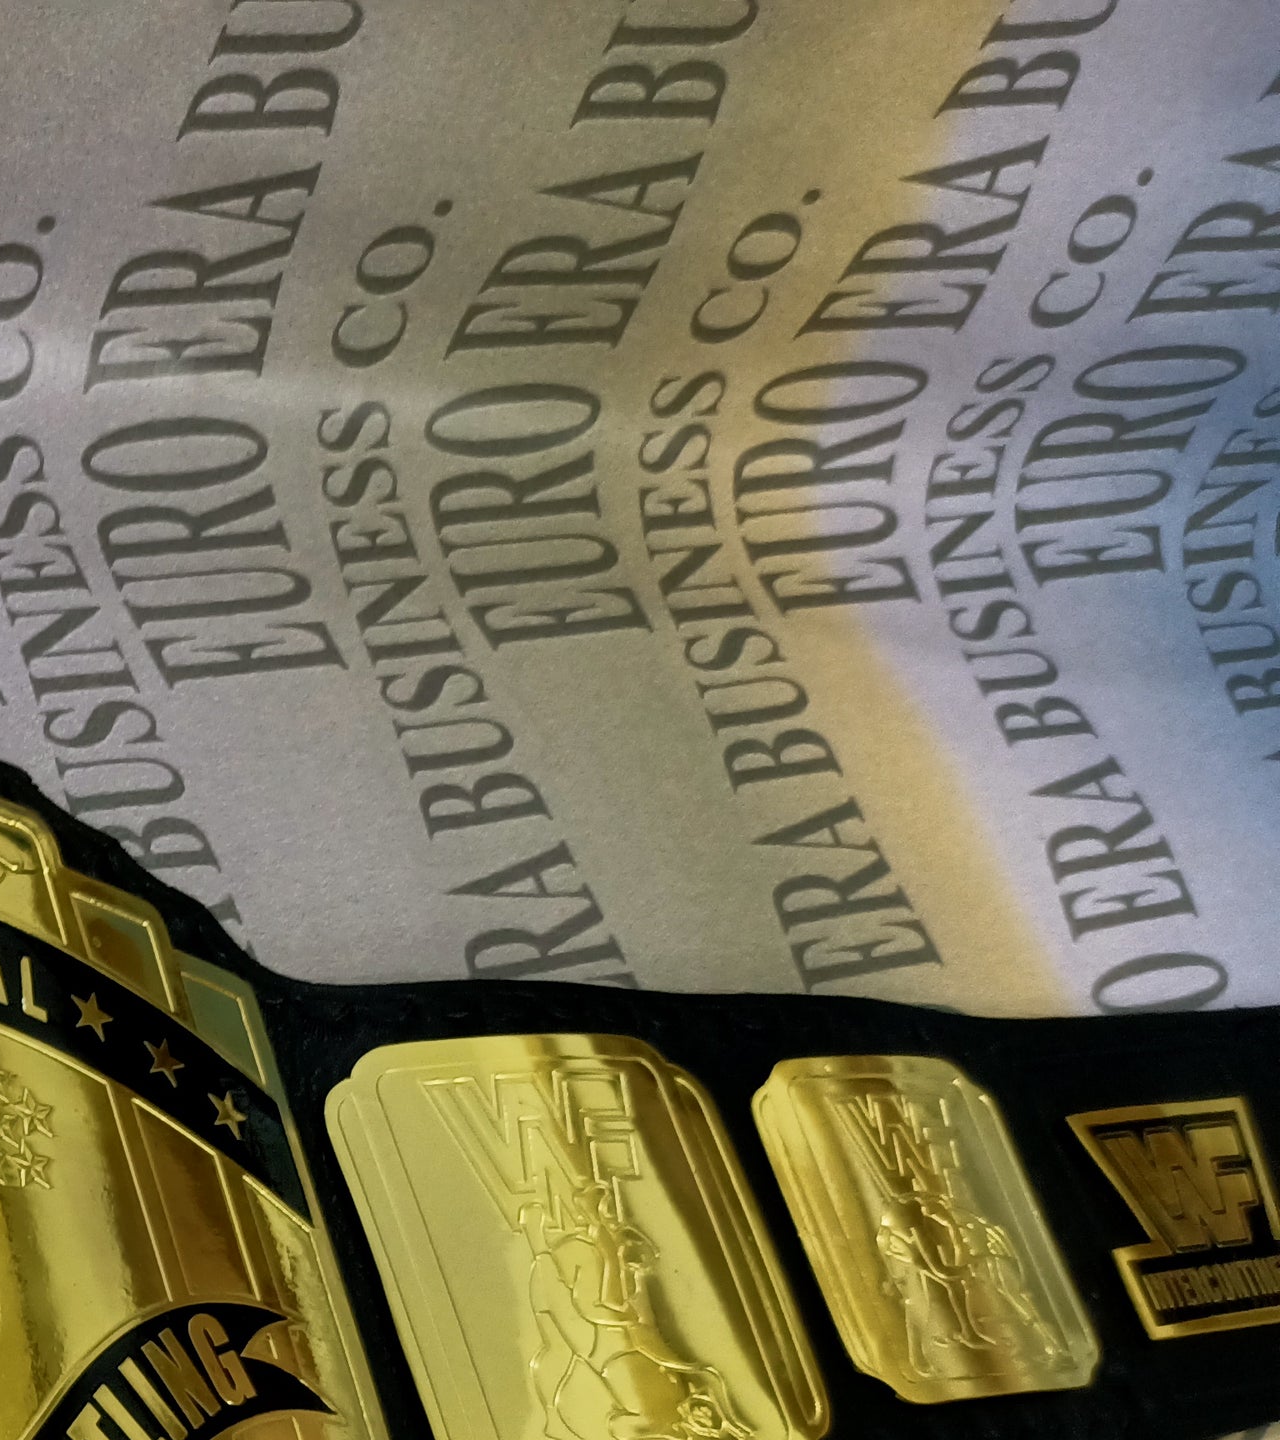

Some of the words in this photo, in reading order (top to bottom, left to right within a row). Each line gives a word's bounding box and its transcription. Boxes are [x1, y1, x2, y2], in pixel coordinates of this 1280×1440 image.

[83, 161, 323, 394] ERA
[331, 198, 454, 368] CO.
[444, 150, 705, 362] ERA
[690, 187, 823, 344] CO.
[793, 133, 1051, 342] ERA
[1030, 165, 1155, 329] CO.
[81, 416, 350, 689] EURO
[424, 382, 654, 652] EURO
[636, 368, 844, 795] BUSINESS
[732, 359, 930, 616] EURO
[926, 352, 1100, 748] BUSINESS
[1014, 344, 1249, 590] EURO
[316, 401, 554, 840] BUSINESS
[750, 795, 944, 993] ERA
[1027, 754, 1200, 942] ERA
